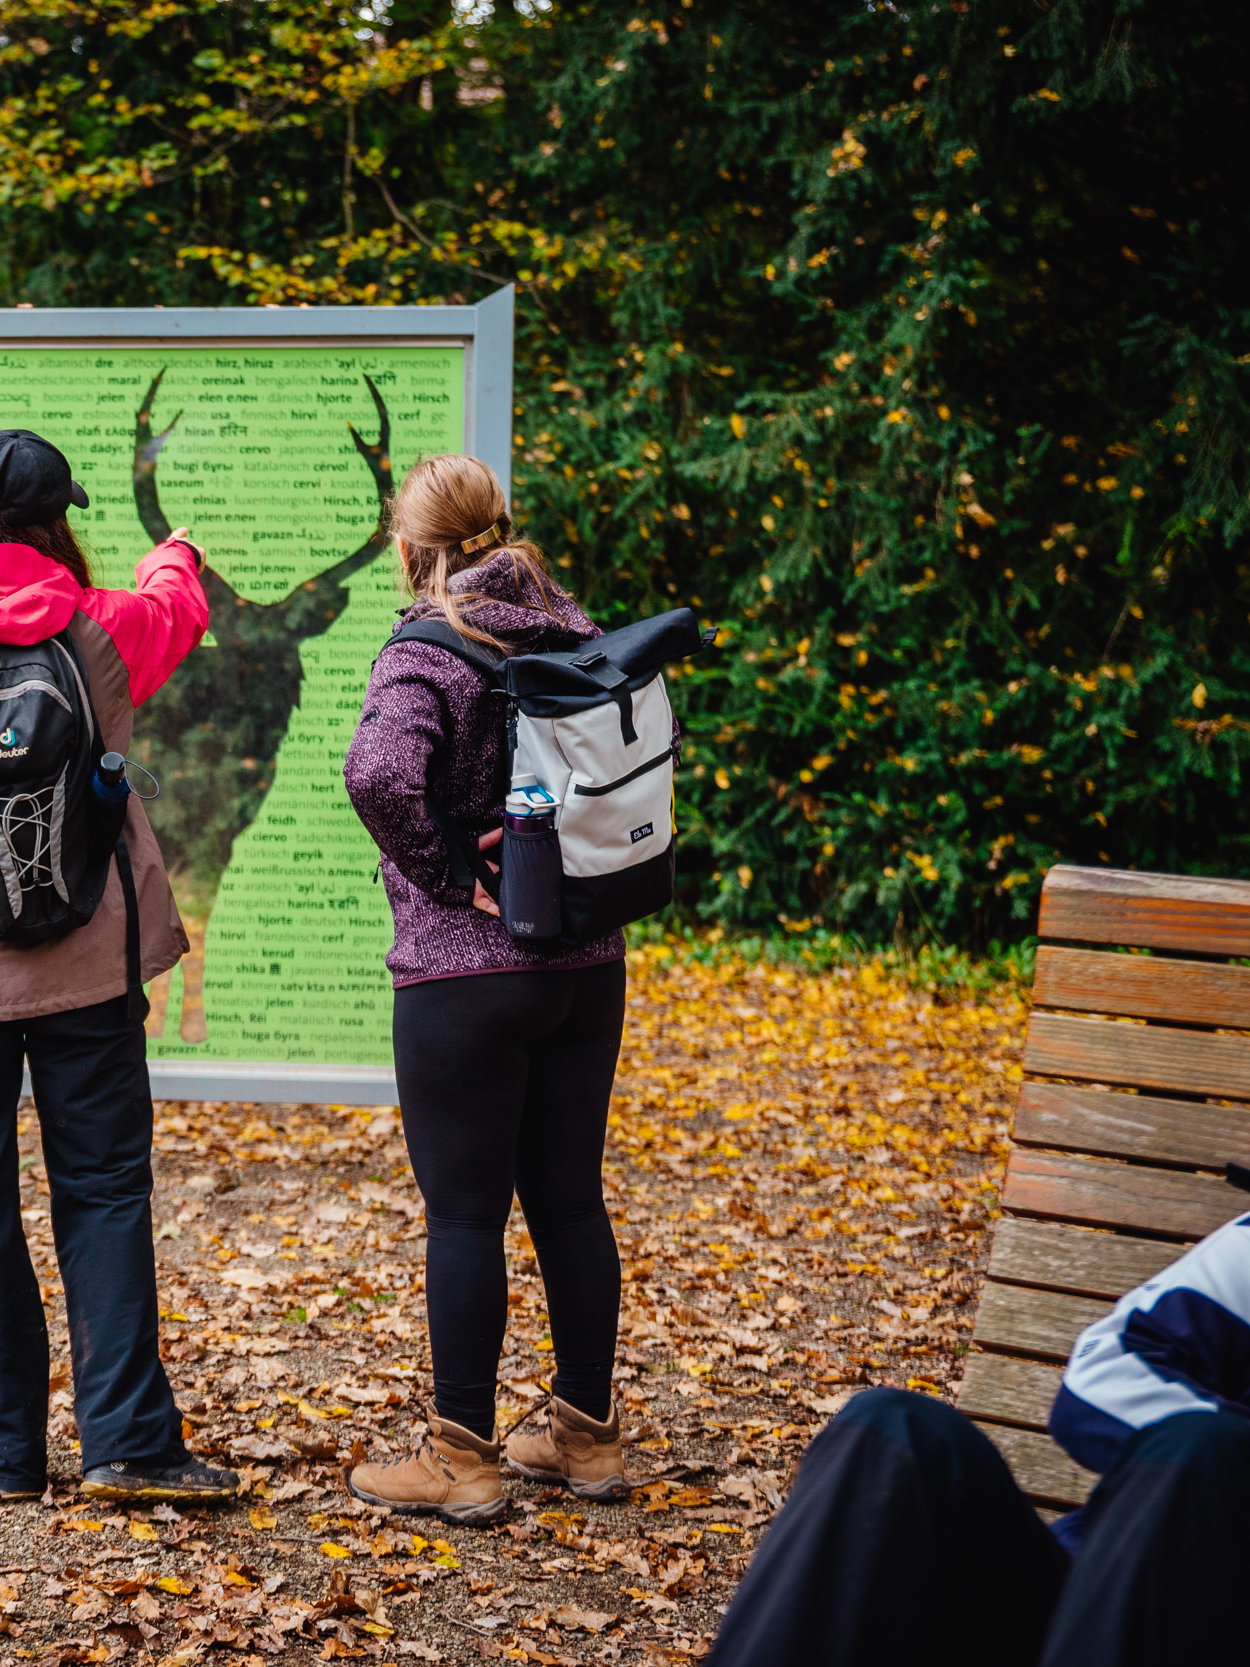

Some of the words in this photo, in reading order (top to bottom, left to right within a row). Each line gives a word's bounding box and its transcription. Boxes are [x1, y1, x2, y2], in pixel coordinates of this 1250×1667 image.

[38, 357, 93, 368] albanisch
[95, 357, 114, 368] dre
[215, 357, 241, 371] hirz,
[244, 357, 274, 368] hiruz
[283, 357, 332, 368] arabisch
[388, 357, 451, 368] armenisch
[108, 374, 142, 385] maral
[202, 374, 246, 386] oreinak
[321, 375, 359, 386] harina
[95, 391, 126, 405] jelen
[198, 391, 223, 402] elen
[316, 391, 353, 406] hjorte
[412, 392, 450, 403] Hirsch
[41, 410, 73, 419] cervo
[211, 410, 231, 419] usa
[291, 408, 318, 420] hirvi
[398, 409, 421, 420] cerf
[185, 425, 215, 437] hiran
[239, 445, 271, 454] cervo
[173, 459, 199, 474] bugi
[160, 478, 204, 487] saseum
[293, 477, 322, 488] cervi
[192, 493, 227, 504] elnias
[323, 494, 363, 508] Hirsch,
[80, 509, 91, 520] lu
[192, 510, 222, 525] jelen
[336, 511, 365, 526] buga
[252, 530, 294, 542] gavazn
[228, 561, 257, 575] jelen
[324, 667, 356, 676] cervo
[329, 764, 340, 776] lu
[311, 781, 336, 792] hert
[252, 830, 288, 842] ciervo
[293, 848, 324, 862] geyik
[287, 898, 325, 909] harina
[258, 913, 293, 927] hjorte
[348, 915, 385, 926] Hirsch
[220, 929, 246, 940] hirvi
[322, 931, 345, 942] cerf
[261, 946, 295, 957] kerud
[236, 962, 266, 973] shika
[347, 965, 387, 979] kidang
[266, 995, 294, 1010] jelen
[206, 1011, 245, 1025] Hirsch,
[340, 1017, 365, 1026] rusa
[242, 1028, 271, 1043] buga
[158, 1044, 198, 1056] gavazn
